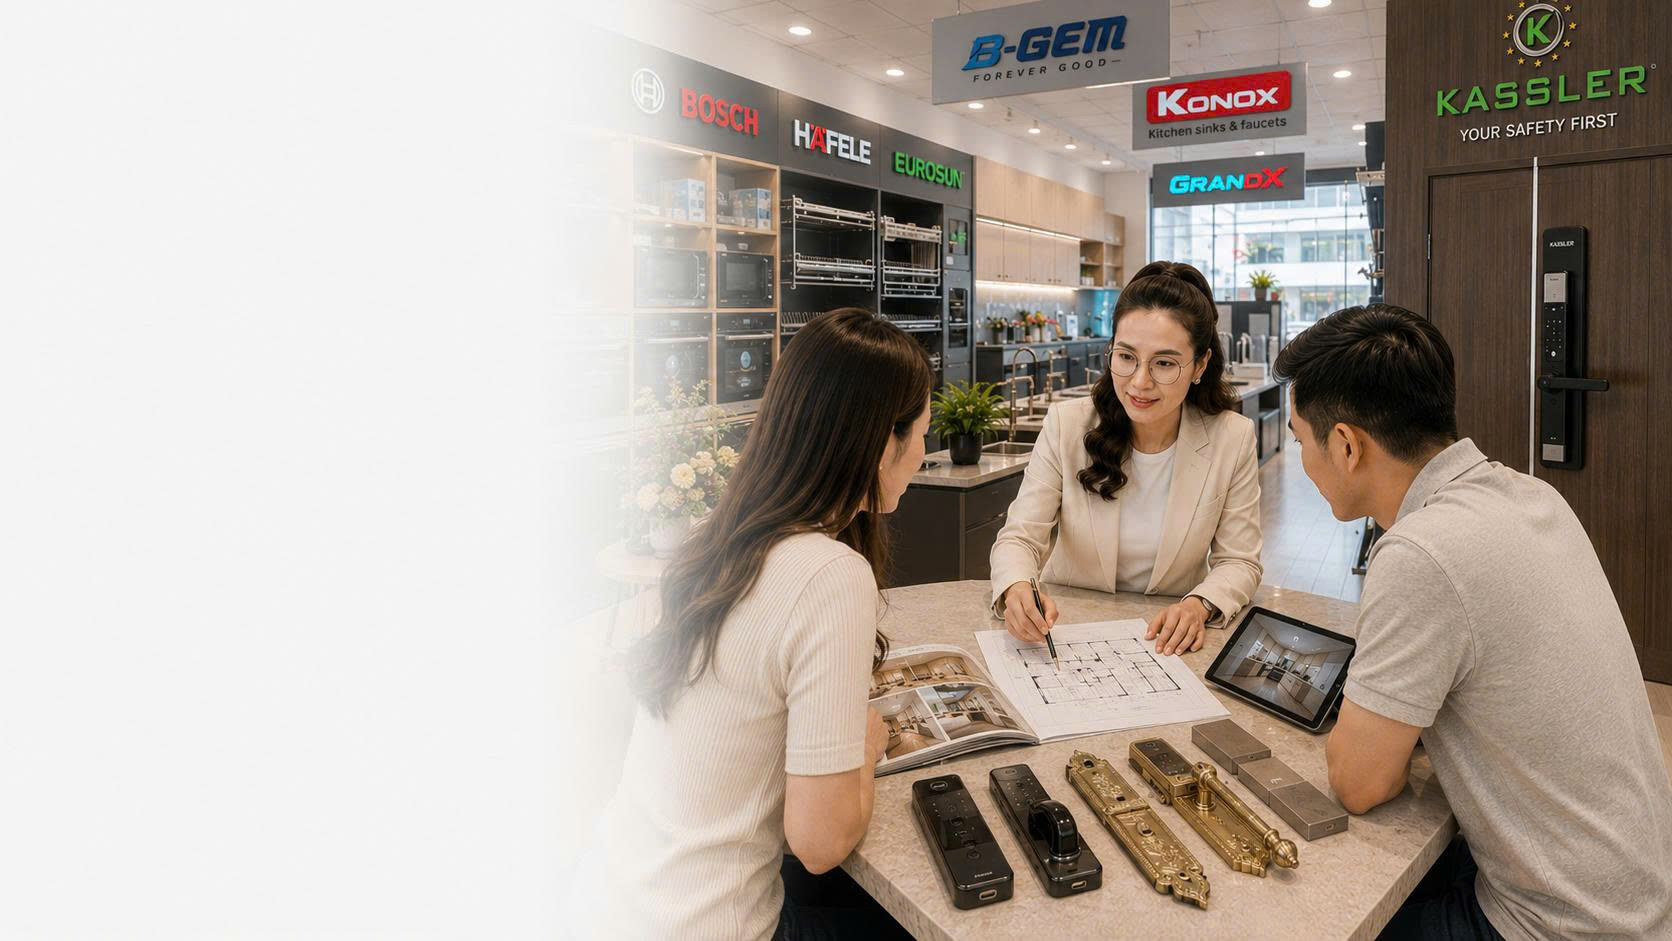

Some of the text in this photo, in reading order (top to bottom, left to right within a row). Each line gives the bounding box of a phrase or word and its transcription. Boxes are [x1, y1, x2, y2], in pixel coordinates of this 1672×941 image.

[961, 15, 1127, 71] B-GEM
[973, 66, 1047, 83] FOREVER
[1436, 65, 1647, 117] KASSLER
[681, 88, 759, 136] BOSCH
[1148, 117, 1287, 139] Kitchen sinks & faucets
[1460, 113, 1618, 142] YOUR SAFETY FIRST
[794, 119, 871, 165] HÄFELE
[894, 151, 962, 189] EUROSUN
